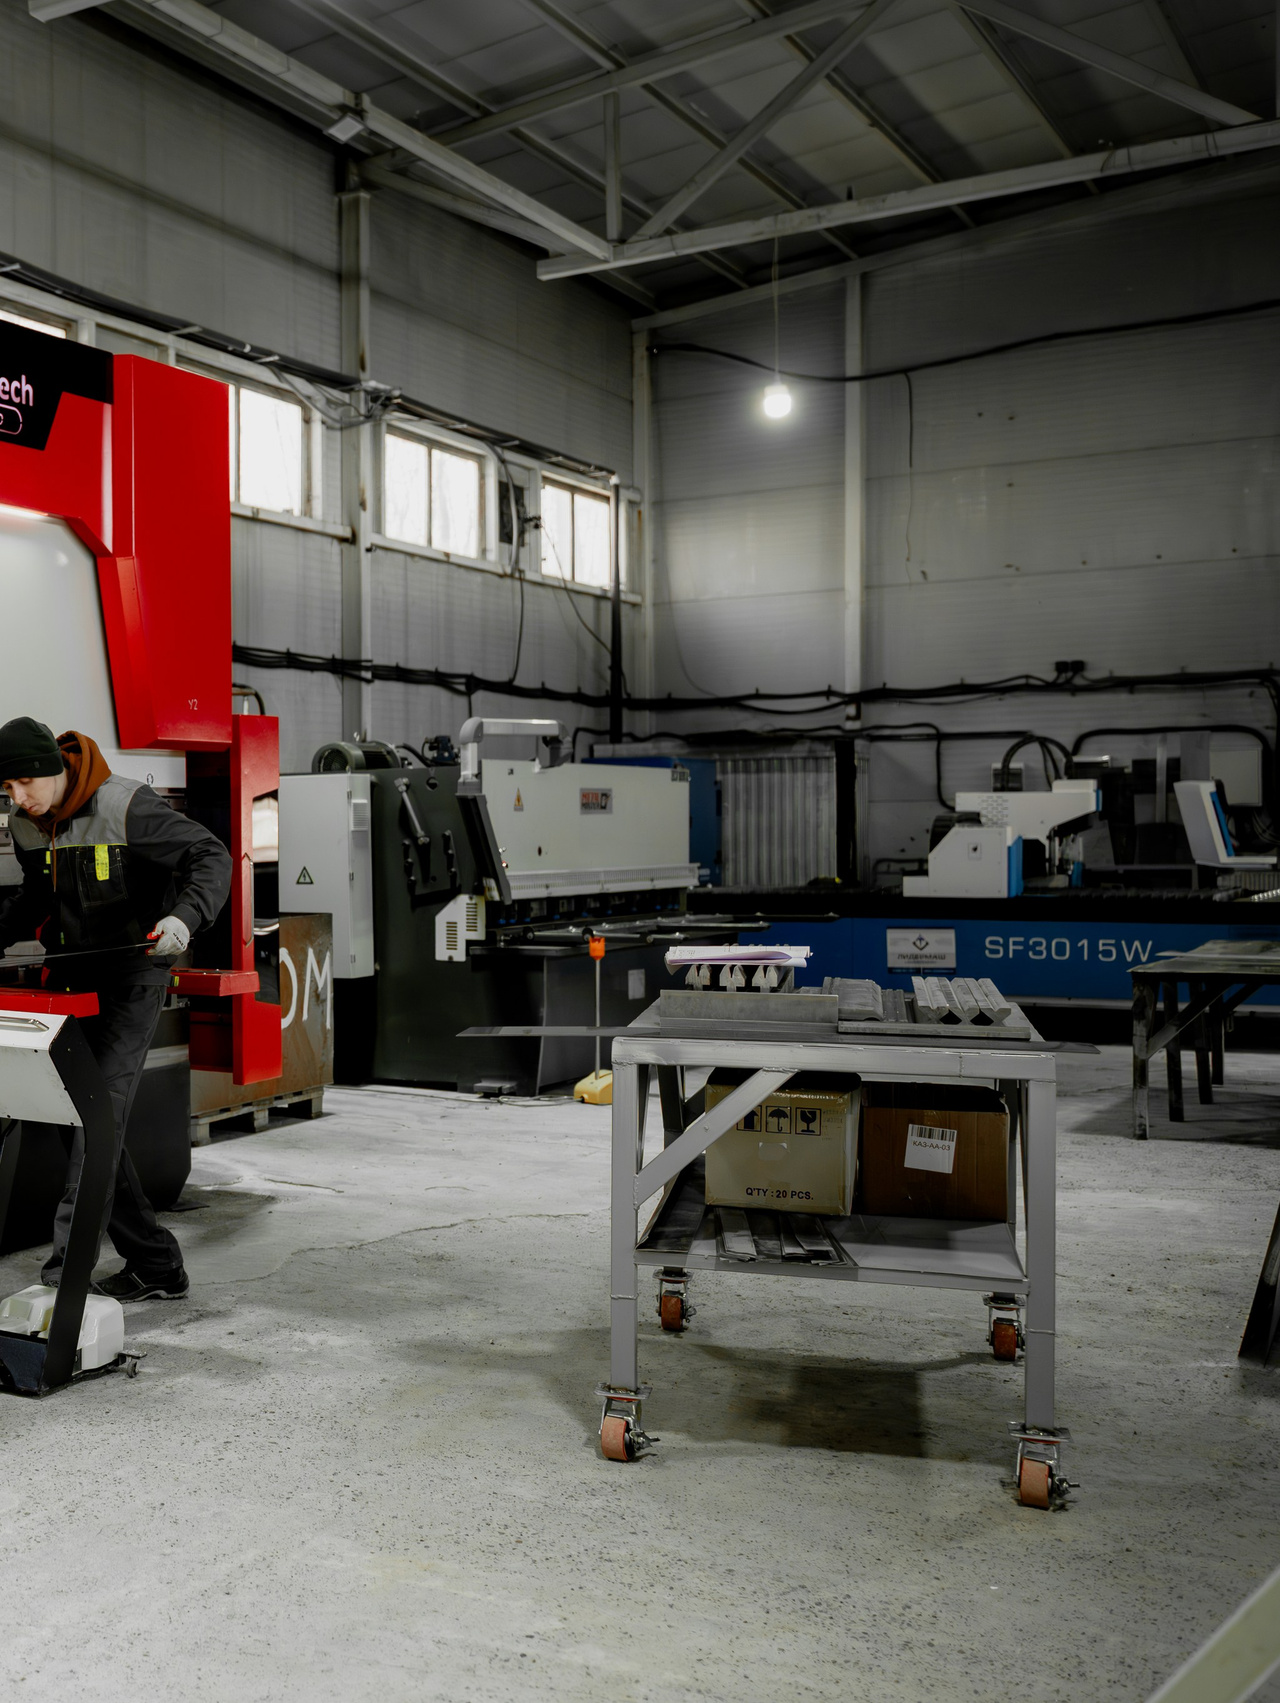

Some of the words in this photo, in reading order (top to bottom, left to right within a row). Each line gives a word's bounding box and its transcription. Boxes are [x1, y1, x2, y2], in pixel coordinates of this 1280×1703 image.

[984, 936, 1153, 963] SF3015W
[745, 1187, 769, 1197] Q'TY
[776, 1190, 787, 1199] 20
[790, 1190, 814, 1200] PCS.
